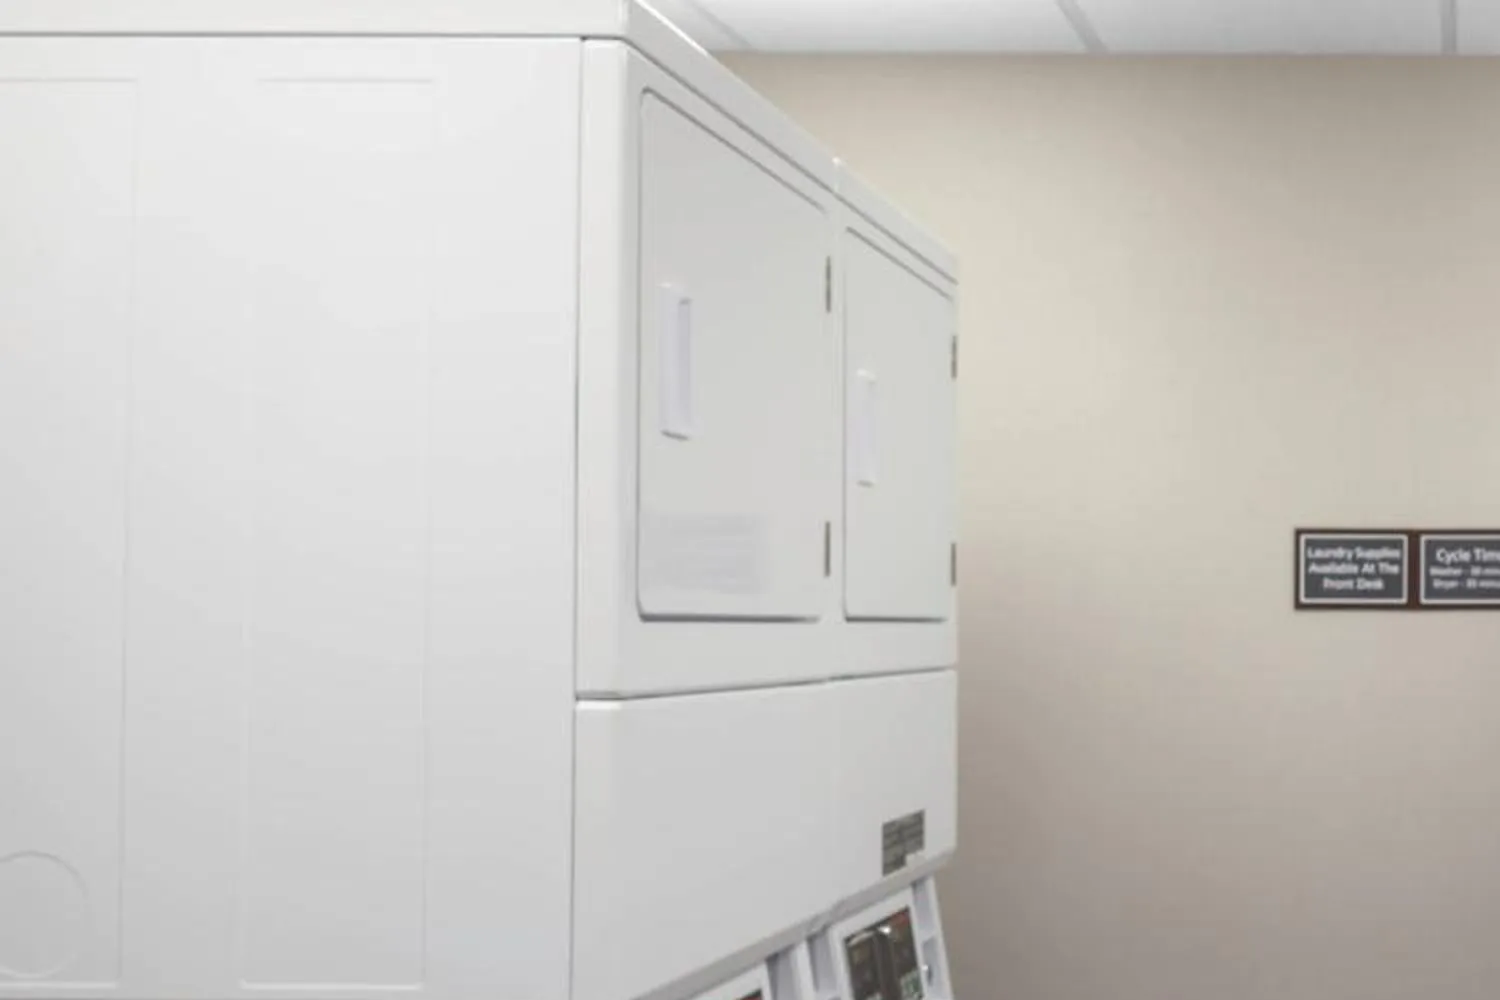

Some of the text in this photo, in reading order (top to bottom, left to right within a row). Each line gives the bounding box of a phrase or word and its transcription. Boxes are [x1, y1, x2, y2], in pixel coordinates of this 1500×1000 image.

[1436, 548, 1470, 566] Cycle
[1362, 562, 1375, 574] At
[1378, 561, 1399, 574] The
[1357, 577, 1384, 590] Desk
